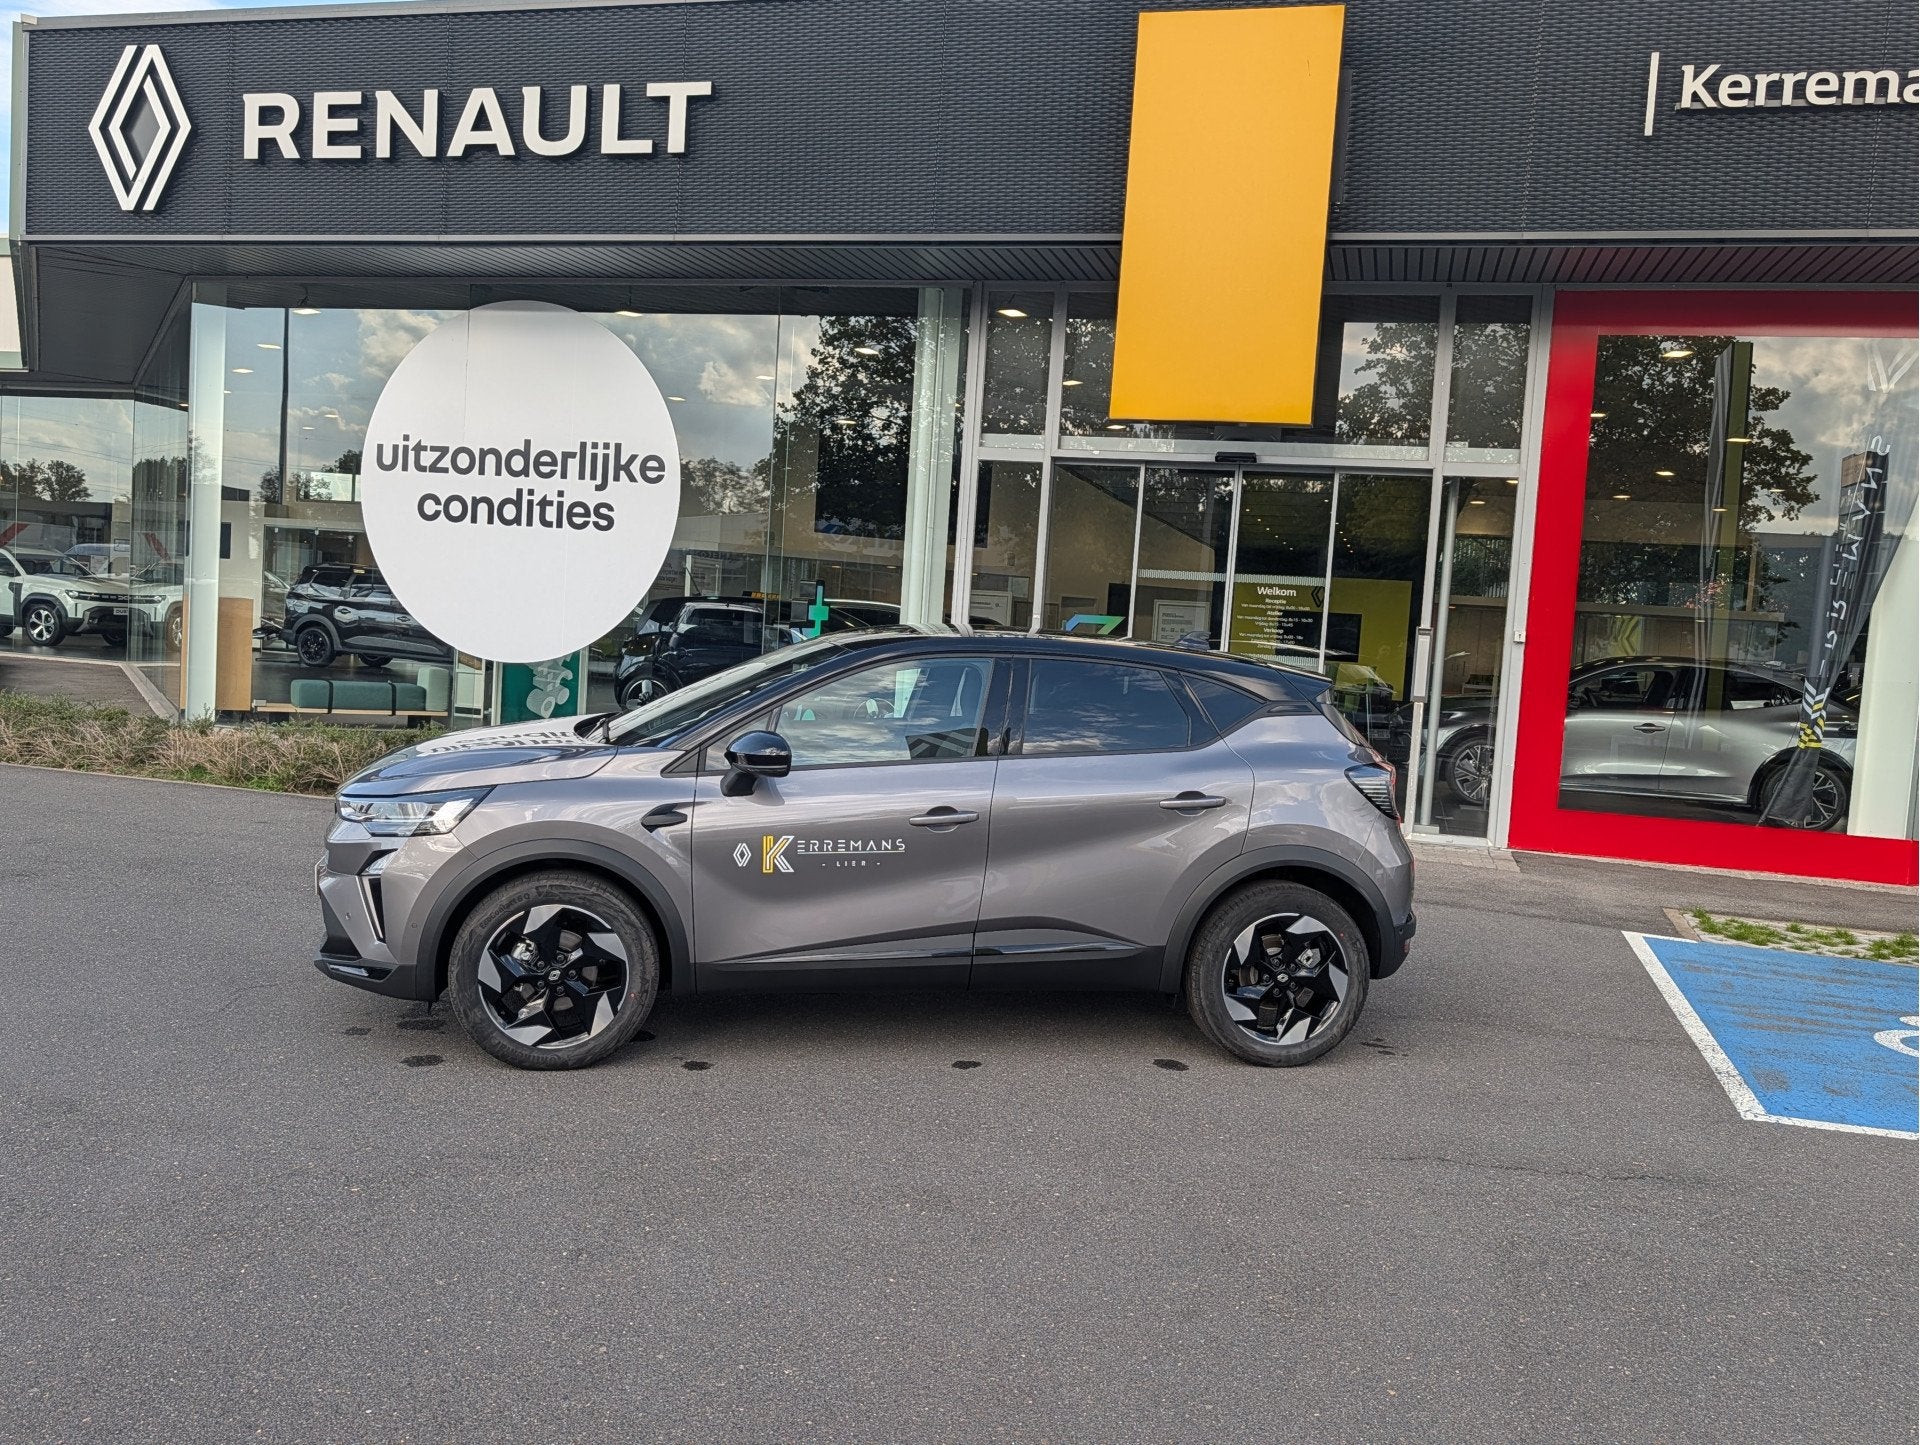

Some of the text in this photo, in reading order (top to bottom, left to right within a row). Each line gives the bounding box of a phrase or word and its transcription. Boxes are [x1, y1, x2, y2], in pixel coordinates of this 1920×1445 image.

[242, 81, 713, 160] RENAULT
[376, 434, 666, 491] uitzonderlijke
[417, 487, 616, 532] condities
[1257, 586, 1296, 597] Welkom
